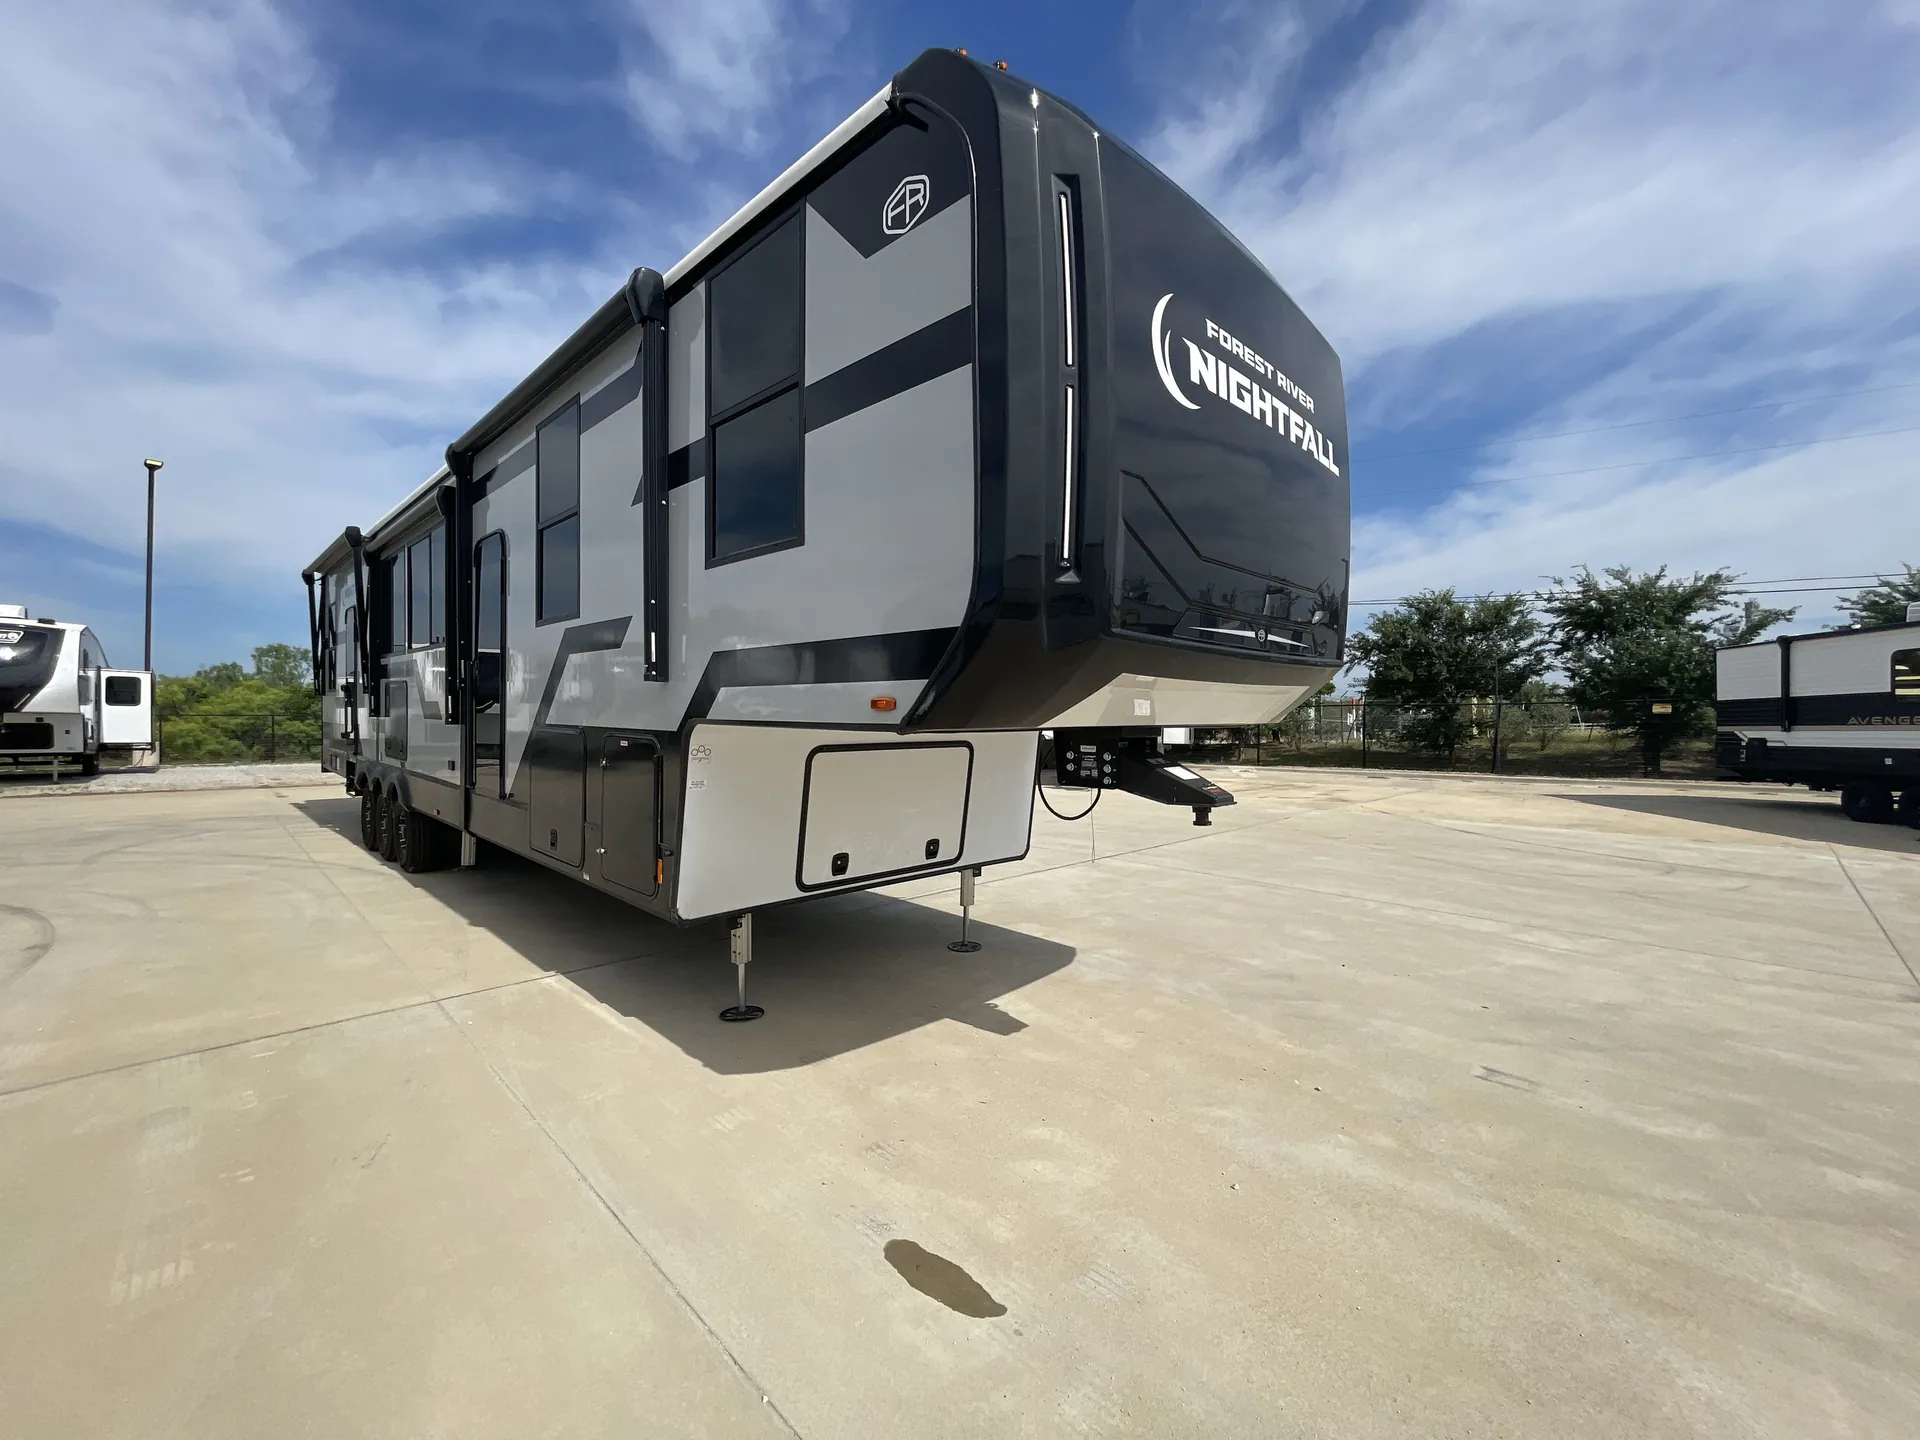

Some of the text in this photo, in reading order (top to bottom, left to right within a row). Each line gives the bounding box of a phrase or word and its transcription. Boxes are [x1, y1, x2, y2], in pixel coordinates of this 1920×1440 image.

[1182, 337, 1340, 477] NIGHTFALL
[1205, 318, 1315, 413] FOREST RIVER
